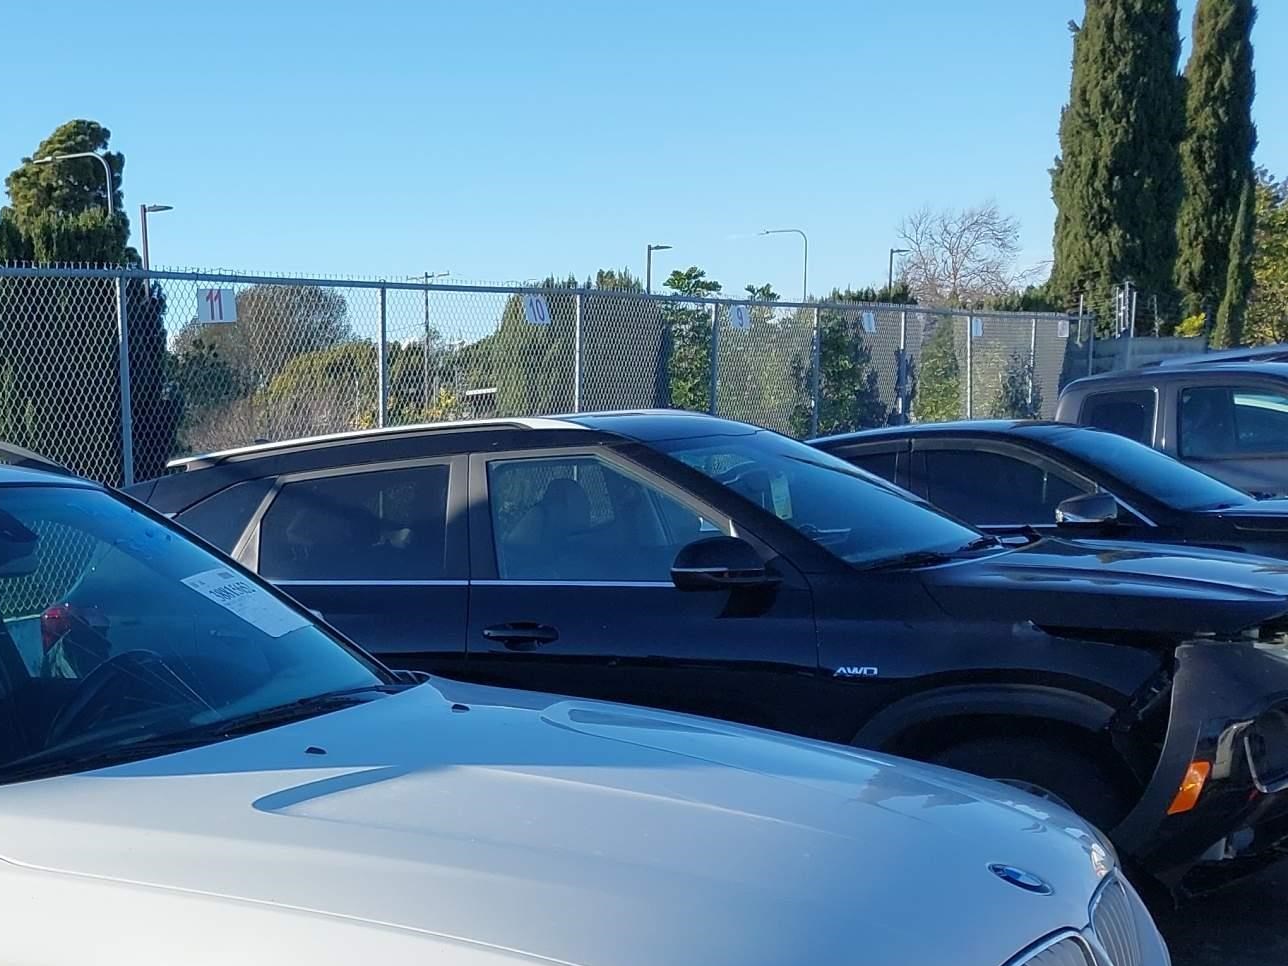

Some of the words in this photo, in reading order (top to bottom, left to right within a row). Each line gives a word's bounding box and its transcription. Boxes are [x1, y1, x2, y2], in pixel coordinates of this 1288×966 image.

[205, 288, 223, 321] 11
[529, 298, 545, 322] 10
[736, 306, 744, 328] 9
[833, 666, 879, 677] AWD
